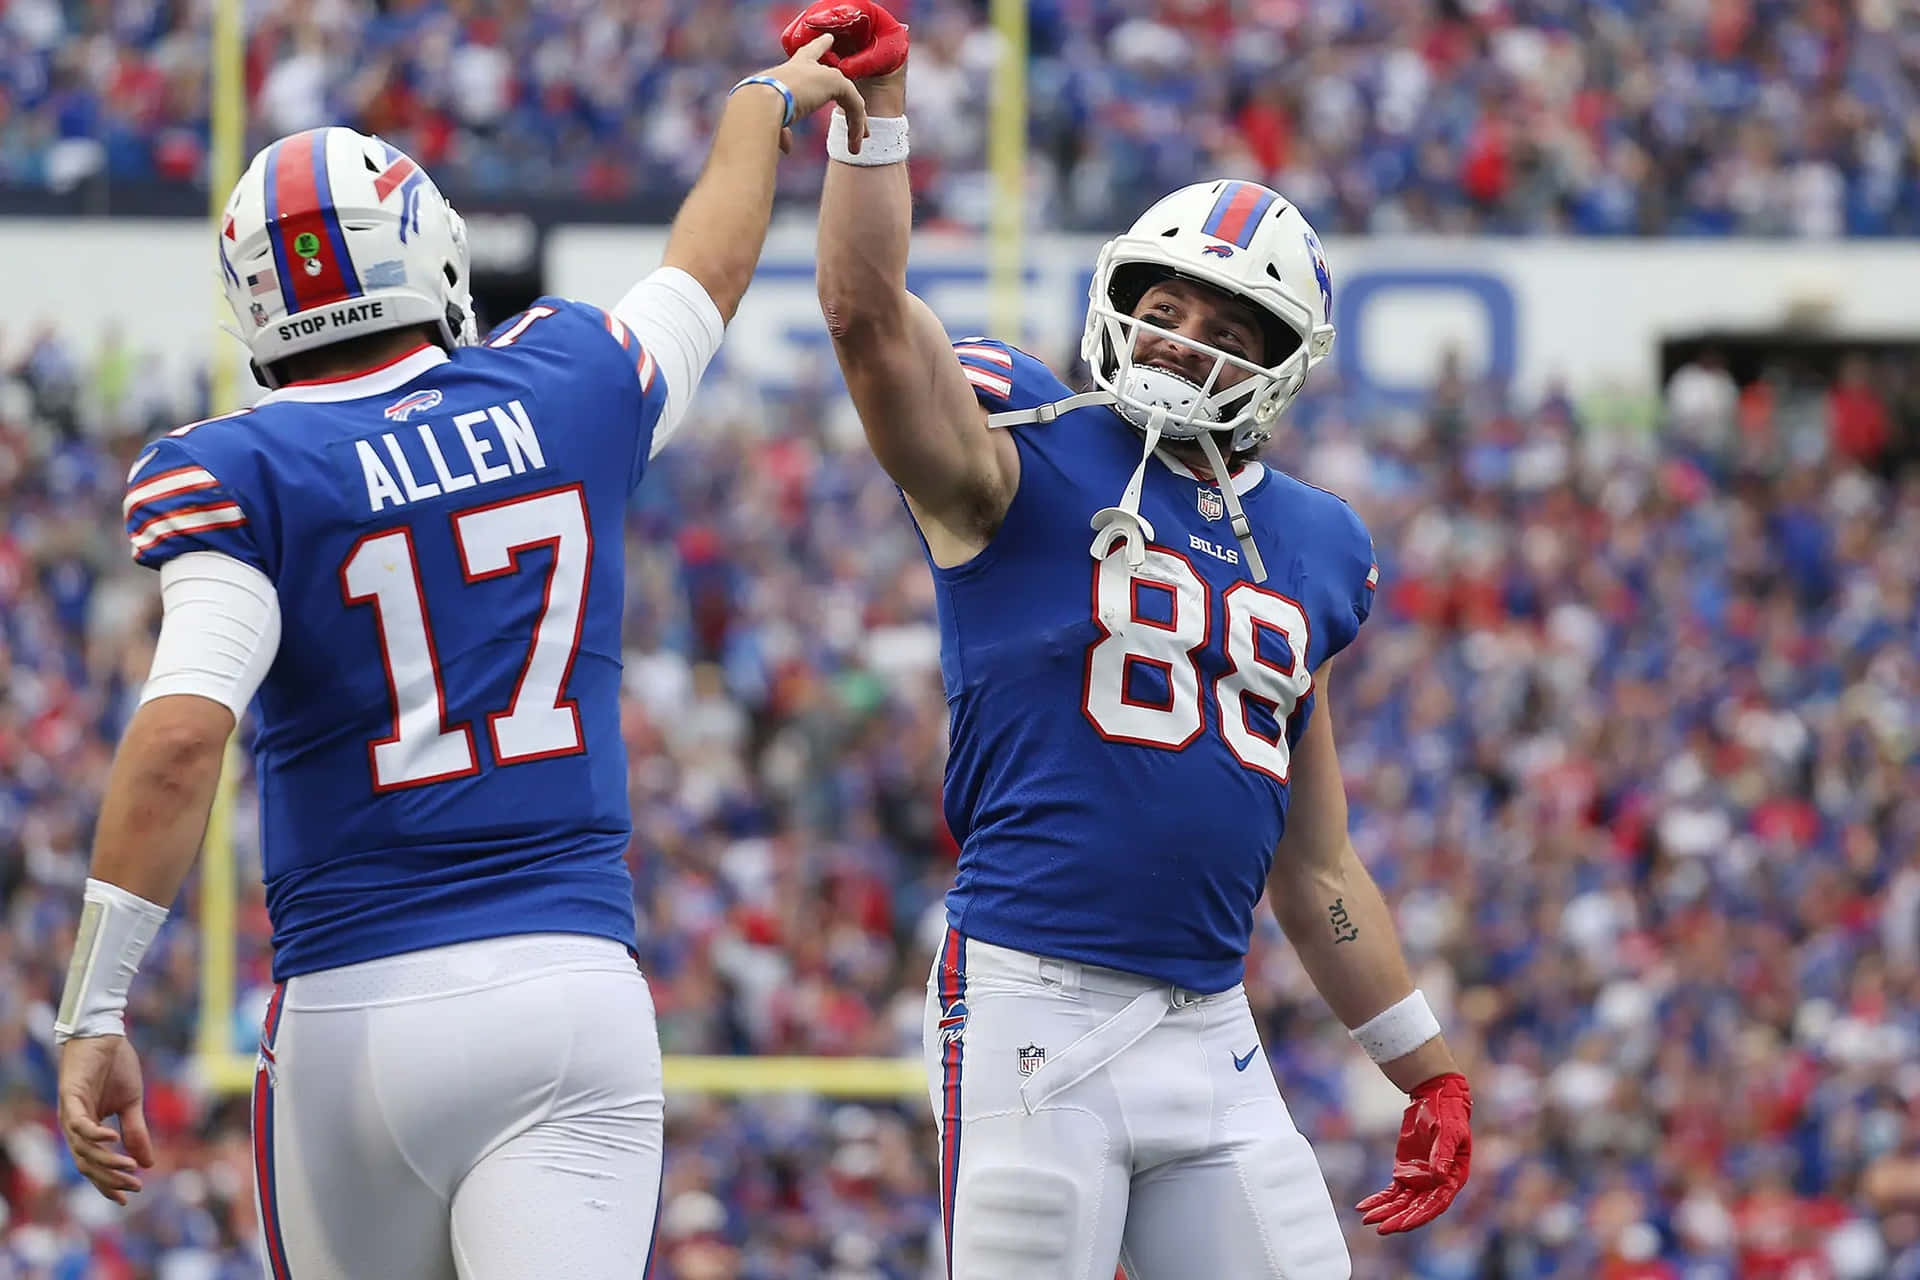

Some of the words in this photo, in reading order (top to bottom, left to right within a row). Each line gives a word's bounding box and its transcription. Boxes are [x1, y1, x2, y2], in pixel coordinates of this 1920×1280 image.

[279, 316, 326, 341] STOP
[331, 302, 383, 327] HATE
[355, 400, 547, 512] ALLEN
[1189, 534, 1239, 565] BILLS
[340, 483, 592, 793] 17
[1082, 543, 1314, 784] 88
